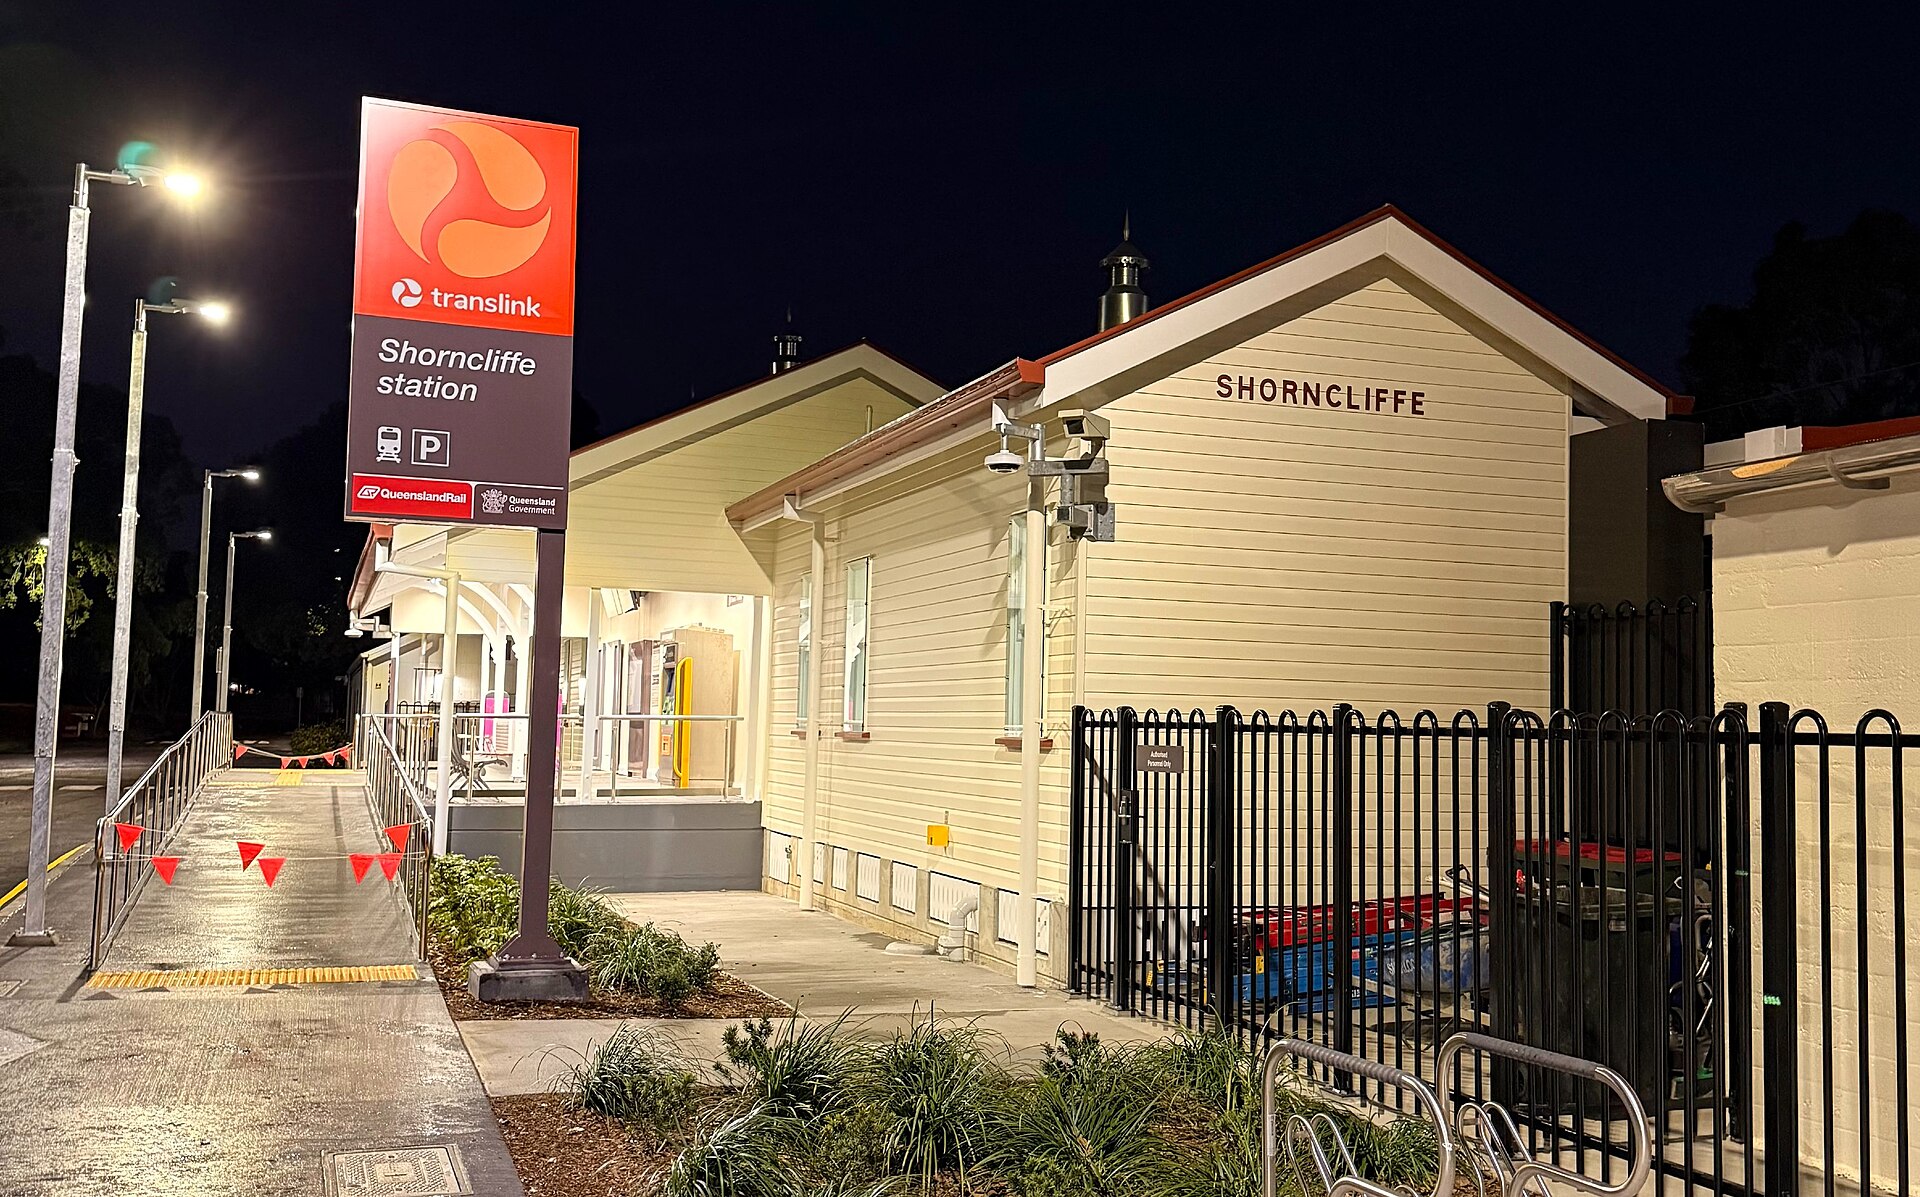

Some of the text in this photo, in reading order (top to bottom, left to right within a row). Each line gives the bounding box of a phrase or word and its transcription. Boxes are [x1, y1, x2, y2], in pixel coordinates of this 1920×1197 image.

[431, 288, 540, 317] translink
[378, 338, 536, 376] Shorncliffe
[376, 374, 477, 402] station
[1216, 374, 1425, 415] SHORNCLIFFE
[380, 487, 467, 504] QueenslandRail
[508, 495, 556, 507] Queensland
[508, 504, 556, 516] Government
